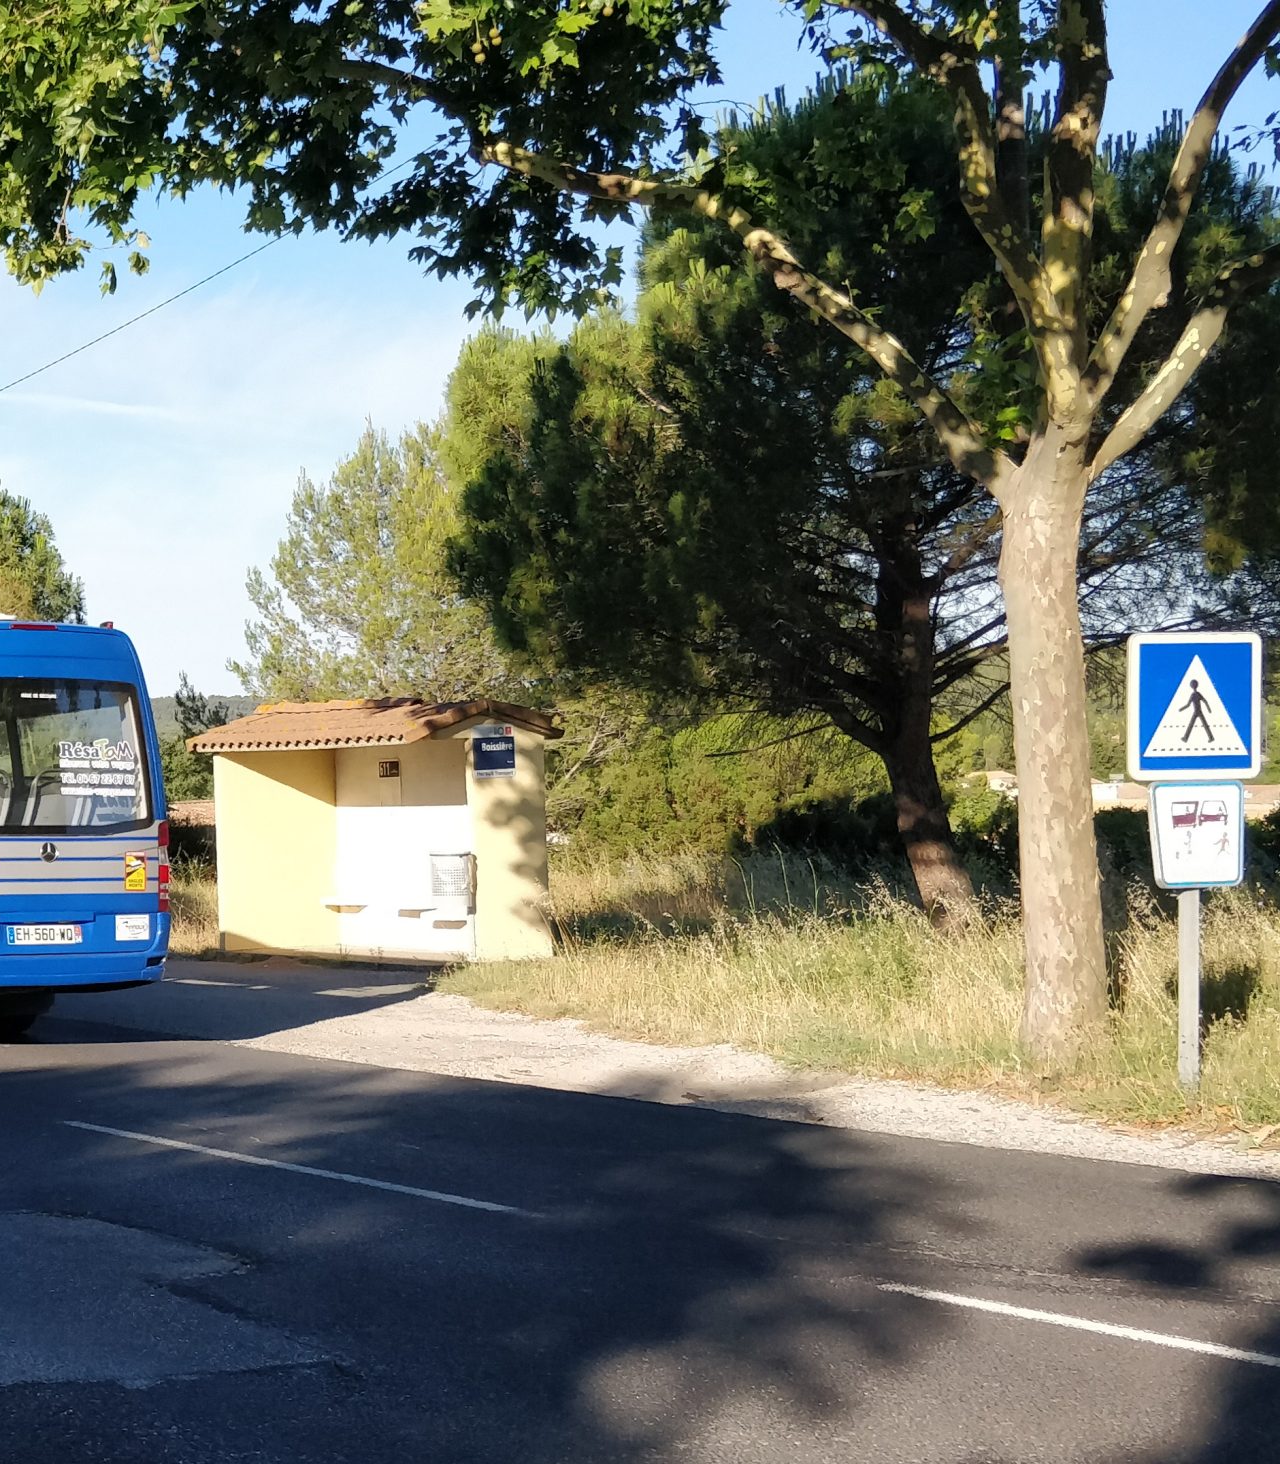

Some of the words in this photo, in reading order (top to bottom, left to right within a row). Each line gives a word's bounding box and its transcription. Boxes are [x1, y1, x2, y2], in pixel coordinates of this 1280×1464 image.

[481, 742, 513, 752] Boissière
[89, 774, 100, 784] 67
[101, 774, 113, 785] 22
[113, 774, 124, 785] 87
[124, 774, 135, 785] 87
[15, 927, 73, 941] EH-560-WQ
